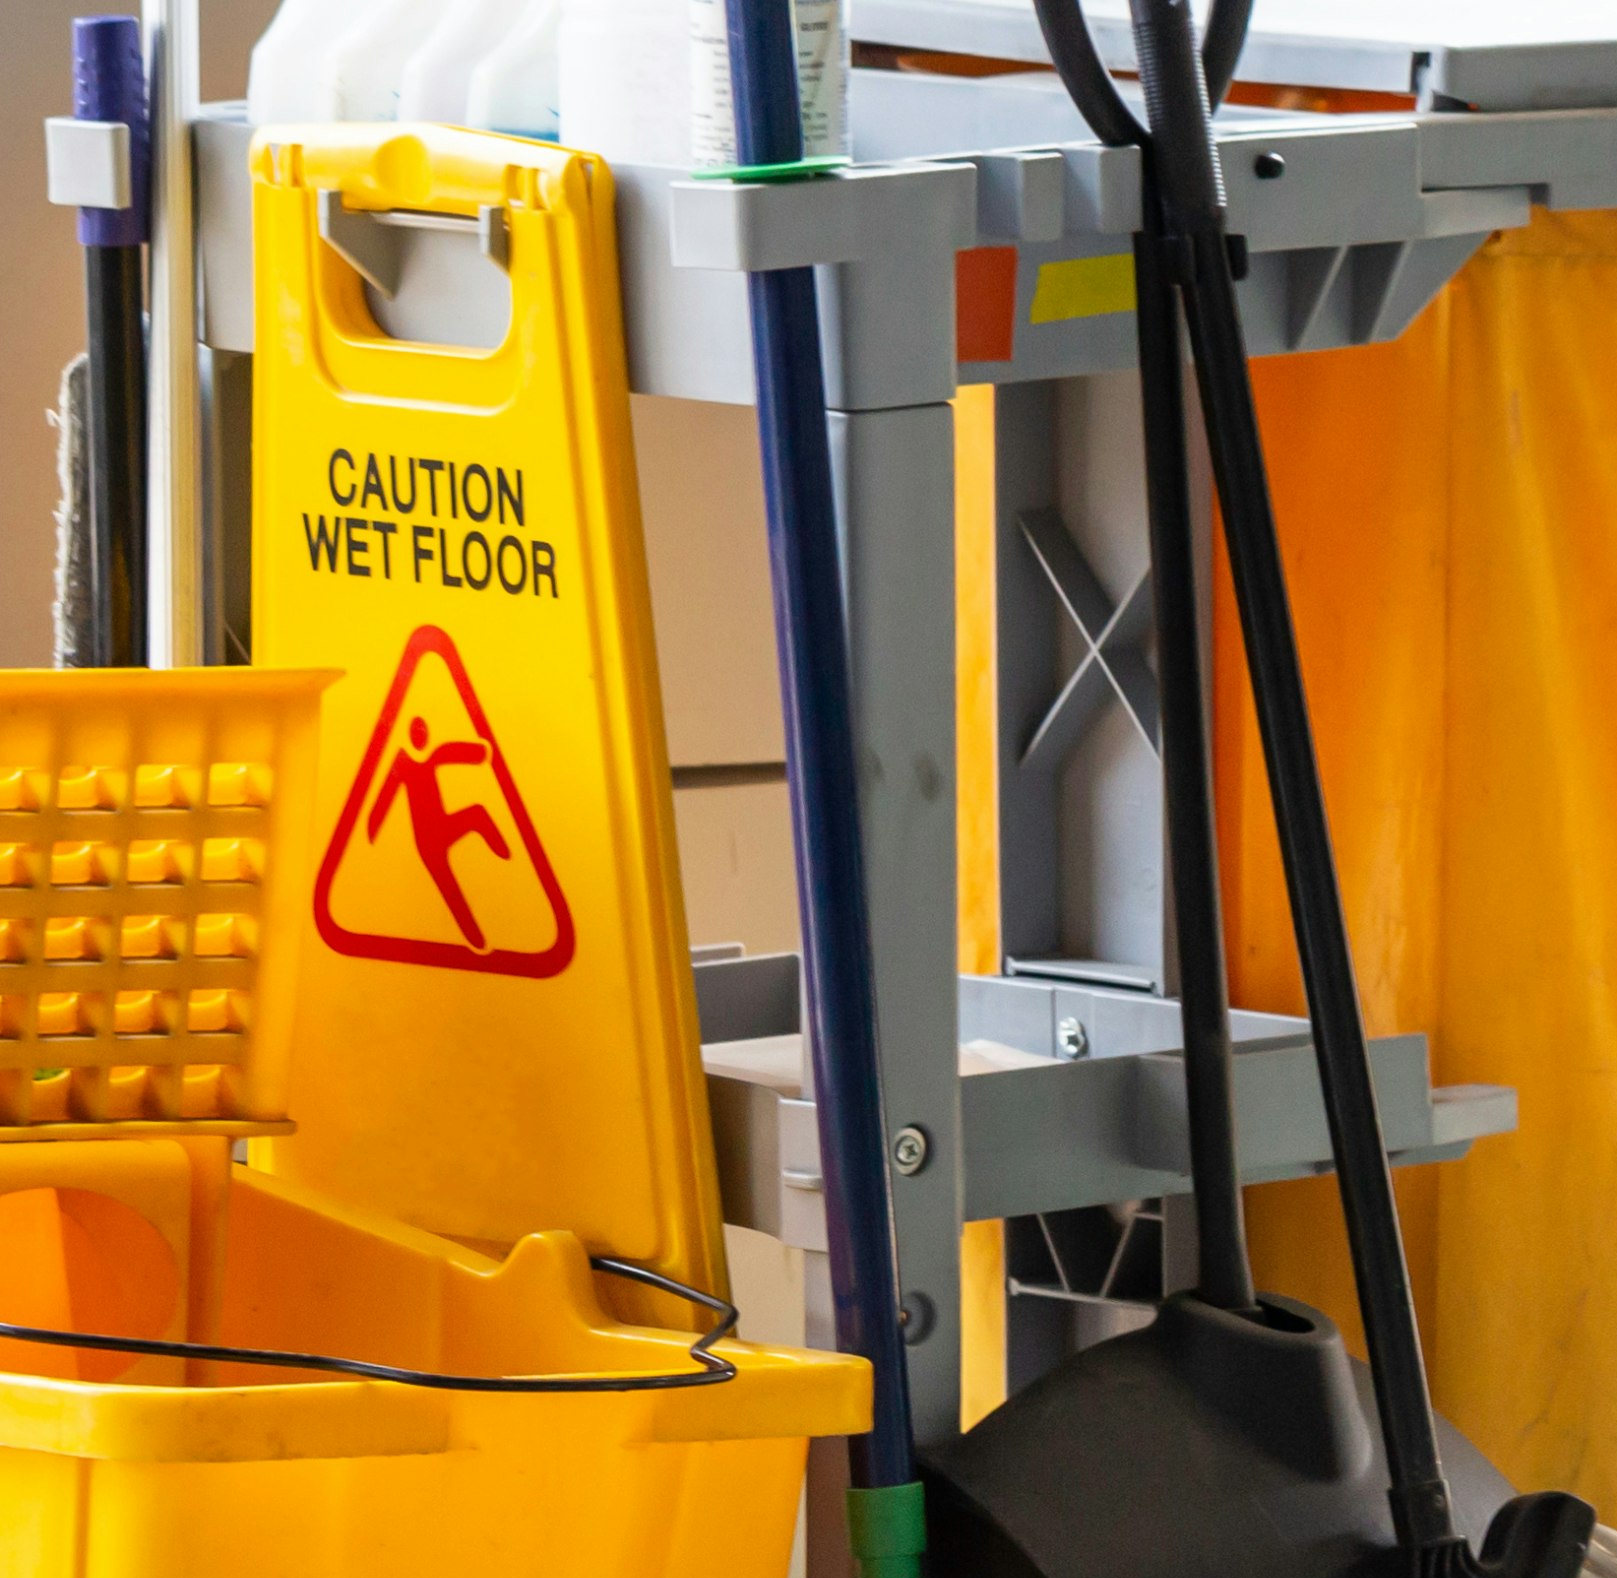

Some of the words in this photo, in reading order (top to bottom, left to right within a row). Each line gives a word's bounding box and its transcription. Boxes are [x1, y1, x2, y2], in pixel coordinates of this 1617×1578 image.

[328, 448, 525, 527] CAUTION
[302, 513, 397, 579] WET
[412, 525, 559, 599] FLOOR
